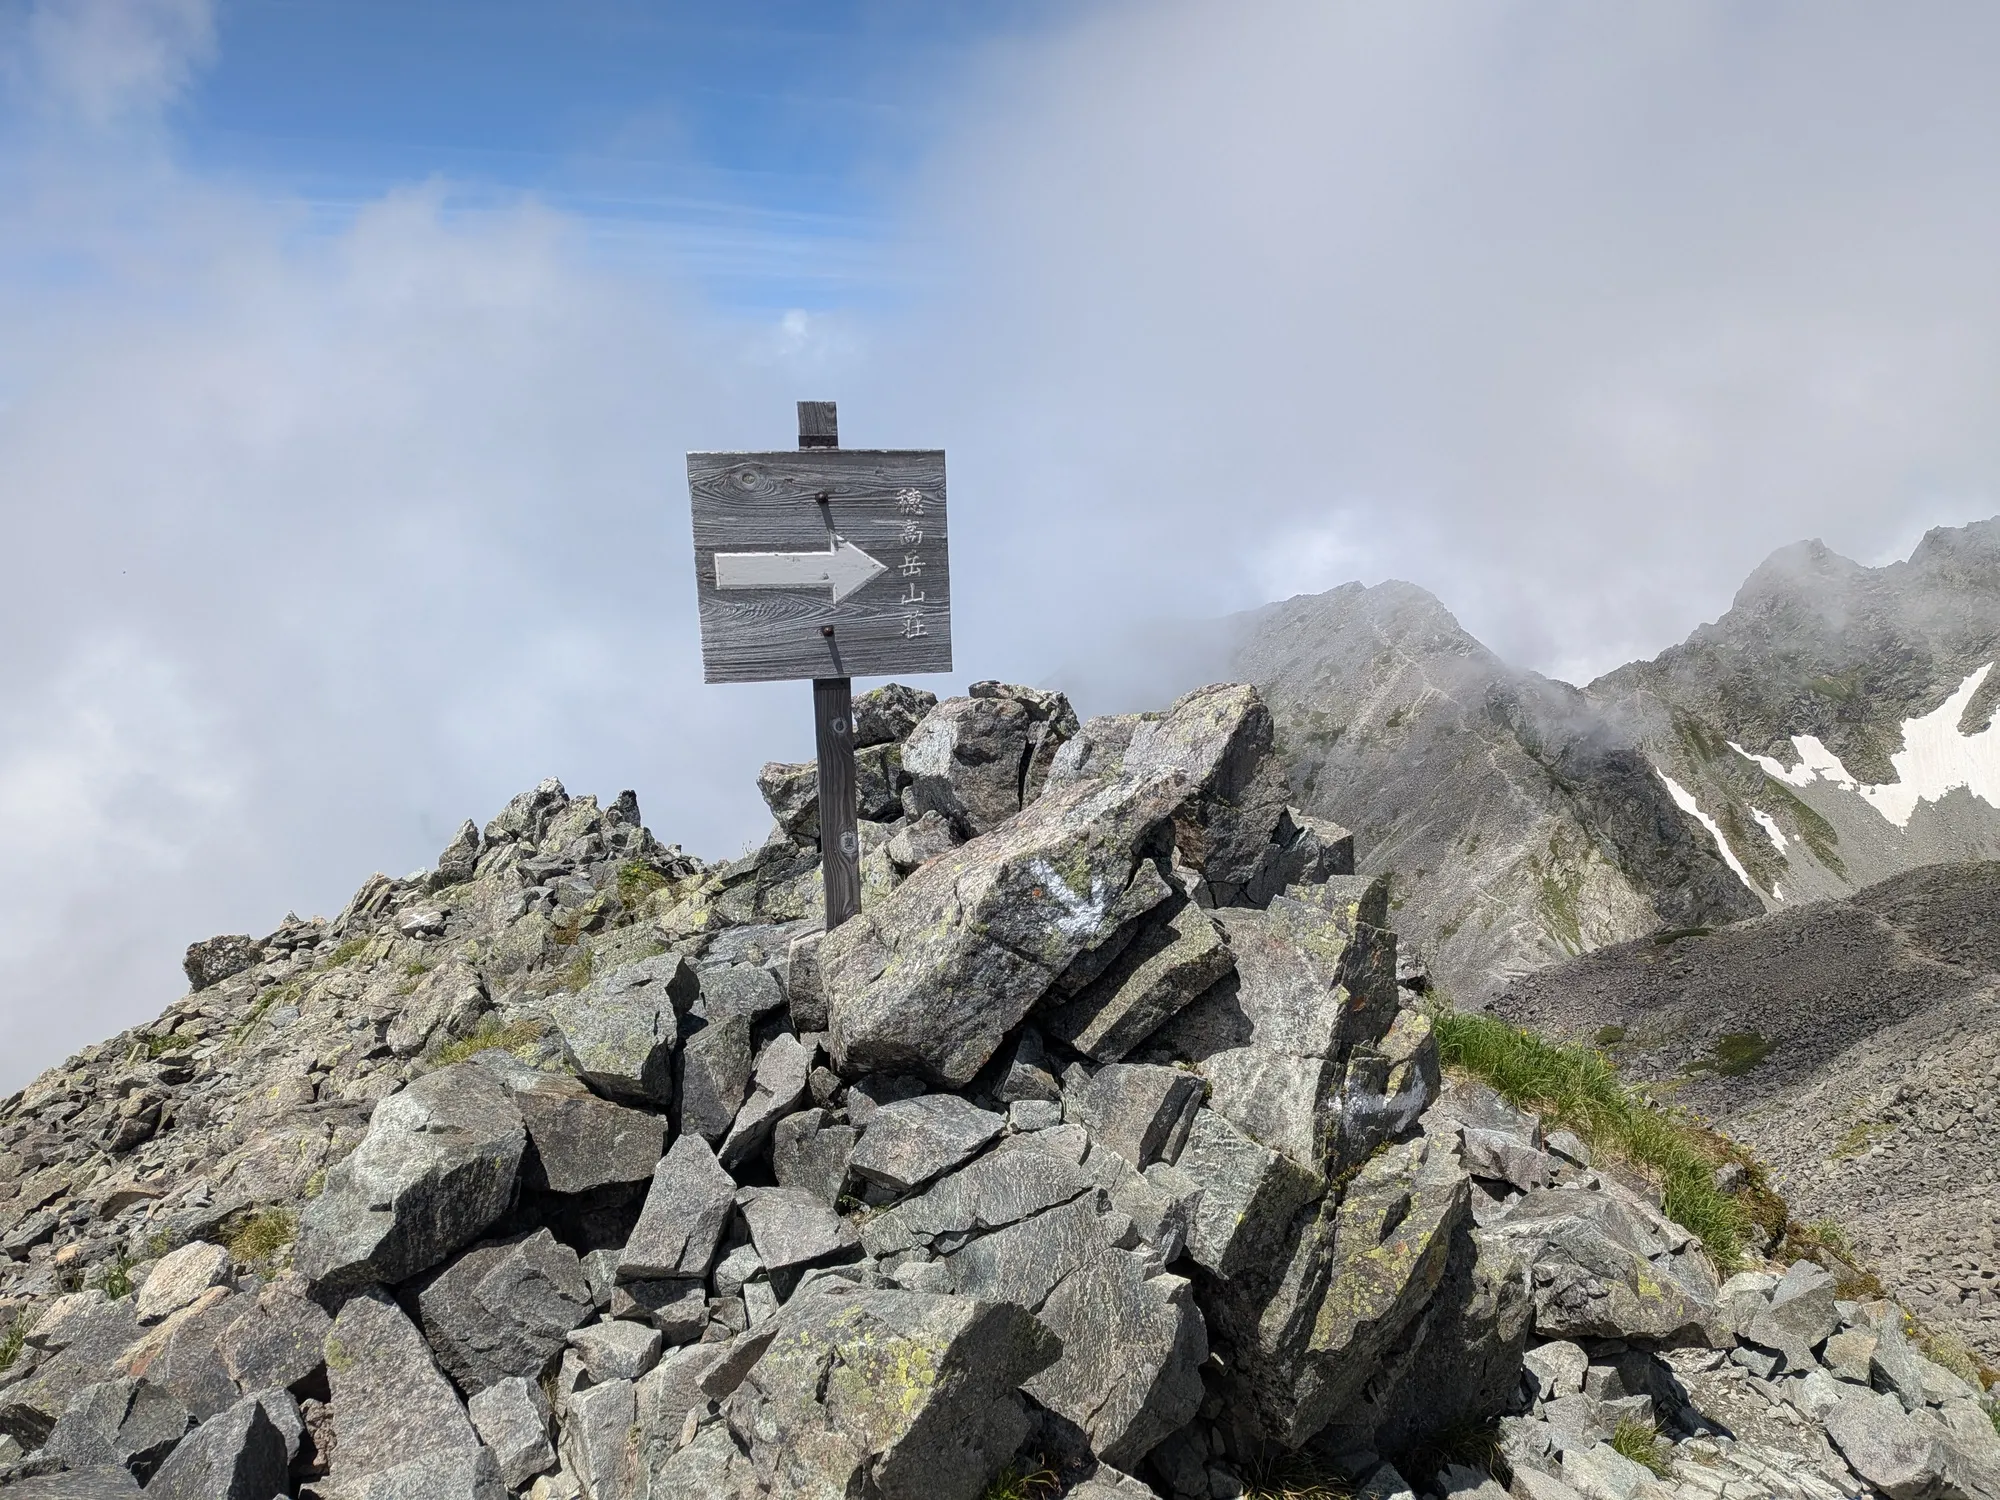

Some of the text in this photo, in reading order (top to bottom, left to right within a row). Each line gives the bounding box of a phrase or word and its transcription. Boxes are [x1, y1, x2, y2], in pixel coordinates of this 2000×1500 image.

[896, 487, 928, 638] 穂高岳山荘
